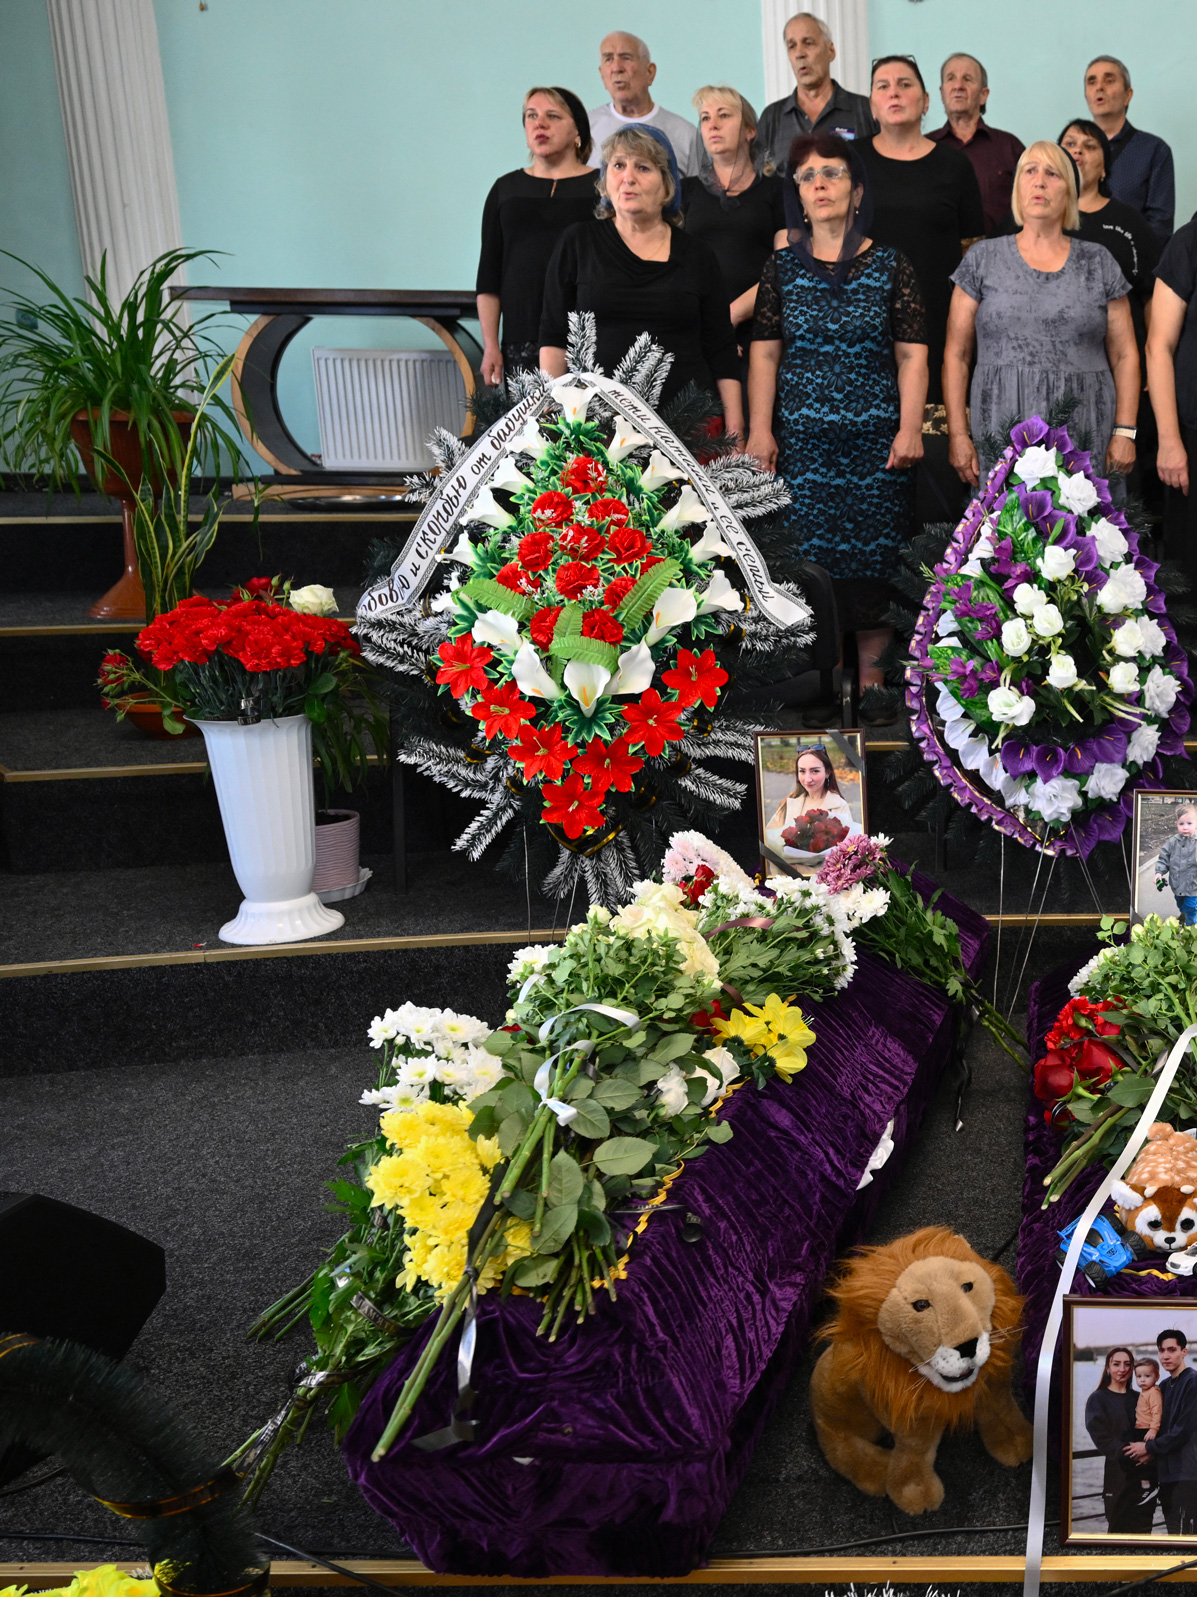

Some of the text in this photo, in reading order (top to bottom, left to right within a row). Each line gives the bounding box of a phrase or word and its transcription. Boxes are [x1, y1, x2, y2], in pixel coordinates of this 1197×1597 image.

[409, 562, 420, 576] и
[416, 475, 471, 557] скорбью
[472, 452, 491, 474] от
[710, 502, 719, 511] и
[719, 515, 742, 534] её
